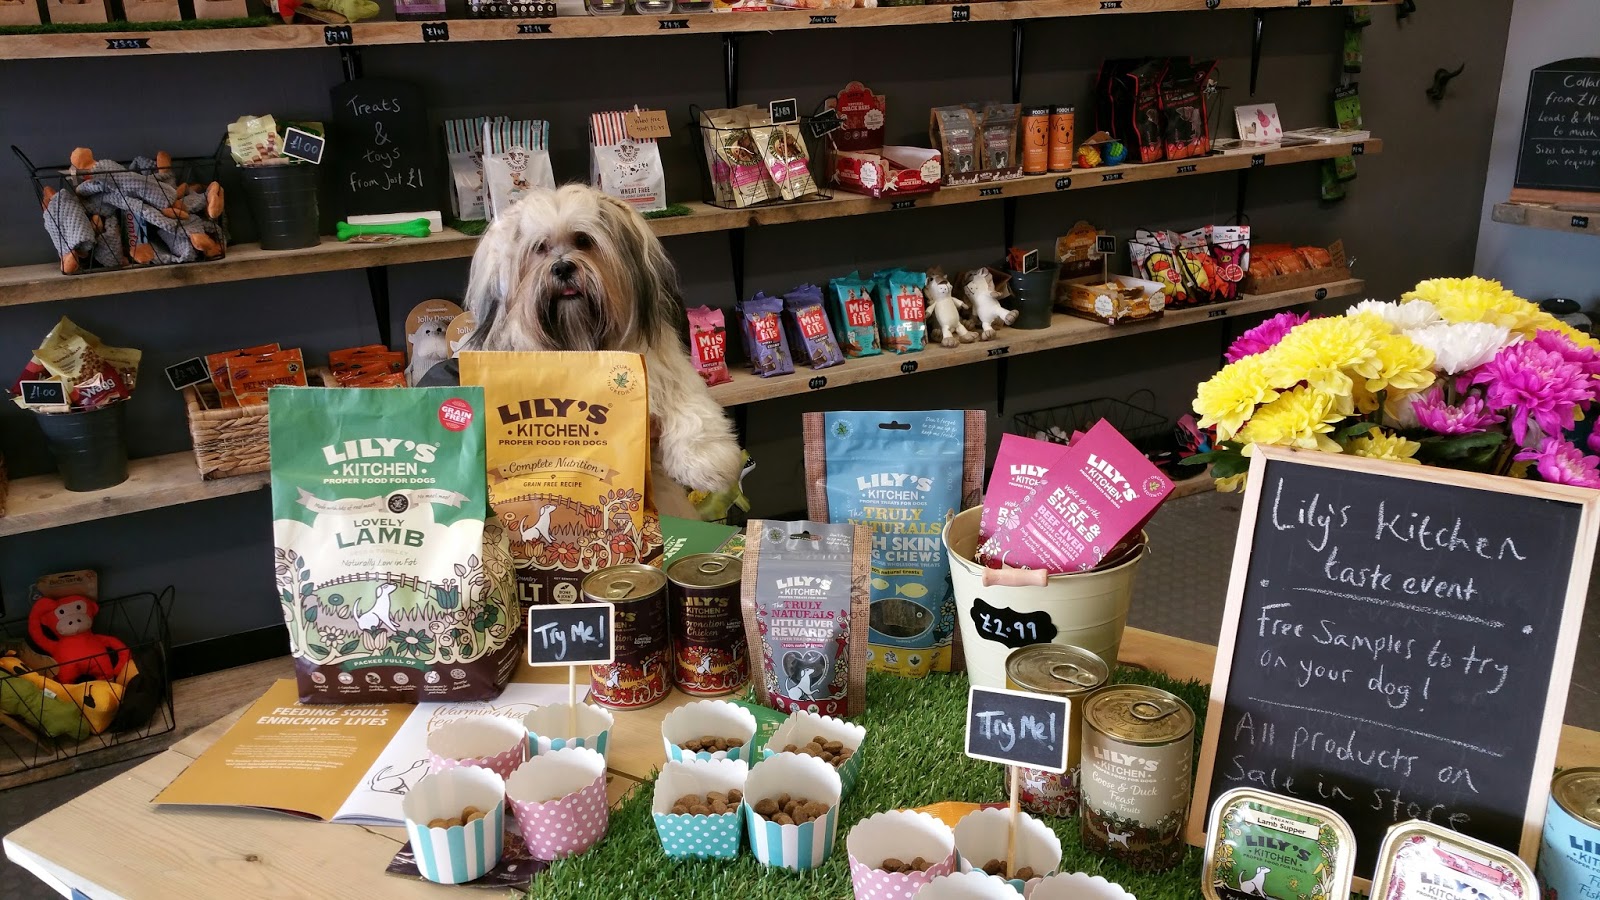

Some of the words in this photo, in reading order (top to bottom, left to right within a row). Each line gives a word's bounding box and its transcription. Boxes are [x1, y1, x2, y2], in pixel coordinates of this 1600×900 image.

[347, 96, 401, 116] Treats
[375, 121, 392, 145] &
[362, 148, 401, 169] toys
[350, 172, 379, 191] from
[81, 378, 116, 399] Wagg
[243, 382, 257, 390] PET
[441, 405, 472, 421] GRAIN
[444, 412, 466, 424] FREE
[497, 398, 610, 425] LILY'S
[517, 424, 590, 437] KITCHEN
[321, 437, 438, 465] LILY'S
[343, 463, 418, 476] KITCHEN
[509, 458, 553, 476] Complete
[555, 457, 598, 473] Nutrition
[1010, 464, 1049, 478] LILY
[856, 473, 933, 492] LILY'S
[1087, 453, 1137, 502] LILY'S
[1088, 468, 1122, 500] KITCHEN
[868, 490, 918, 500] KITCHEN
[1064, 483, 1080, 499] Wake
[848, 508, 863, 517] The
[863, 507, 923, 520] TRULY
[1046, 494, 1095, 543] SHINES
[1053, 487, 1089, 523] RISE
[1088, 523, 1102, 537] &
[1272, 477, 1351, 552] Lily's
[354, 518, 405, 527] LOVELY
[1037, 505, 1061, 528] BEEF
[1058, 526, 1085, 553] LIVER
[335, 527, 425, 549] LAMB
[892, 537, 940, 551] SKIN
[1037, 523, 1061, 547] BOTANICAL
[1061, 547, 1075, 561] HERBS
[1038, 516, 1055, 533] FRESH
[1054, 532, 1079, 558] CARROTS
[341, 558, 375, 570] Naturally
[377, 558, 392, 567] Low
[395, 558, 403, 566] in
[404, 558, 418, 566] Fat
[885, 551, 941, 562] CHEWS
[776, 576, 832, 591] LILY'S
[1324, 547, 1391, 591] taste
[1402, 575, 1477, 601] event
[686, 606, 720, 614] KITCHEN
[771, 610, 835, 619] NATURALS
[784, 601, 822, 610] TRULY
[533, 622, 566, 660] Try
[687, 627, 718, 636] Chicken
[771, 627, 834, 637] REWARDS
[1257, 602, 1304, 637] Free
[1427, 640, 1452, 669] to
[1461, 646, 1509, 694] try
[354, 659, 383, 667] PACKED
[1297, 659, 1353, 688] your
[256, 716, 341, 726] ENRICHING
[344, 718, 388, 726] LIVES
[272, 708, 336, 717] FEEDING
[341, 709, 390, 717] SOULS
[975, 711, 1016, 752] Try
[1093, 746, 1159, 771] LILY'S
[1234, 711, 1276, 746] All
[1291, 726, 1419, 778] products
[1437, 765, 1479, 794] on
[1101, 761, 1146, 778] KITCHEN
[1092, 771, 1115, 789] Goose
[1118, 783, 1128, 793] &
[1130, 785, 1158, 796] Duck
[1318, 774, 1354, 801] in
[1109, 790, 1135, 805] Feast
[1103, 801, 1117, 809] with
[1120, 805, 1140, 814] Fruits
[1257, 817, 1278, 827] Lamb
[1280, 823, 1306, 835] Supper
[1246, 835, 1312, 861] LILY'S
[1254, 848, 1298, 866] KITCHEN
